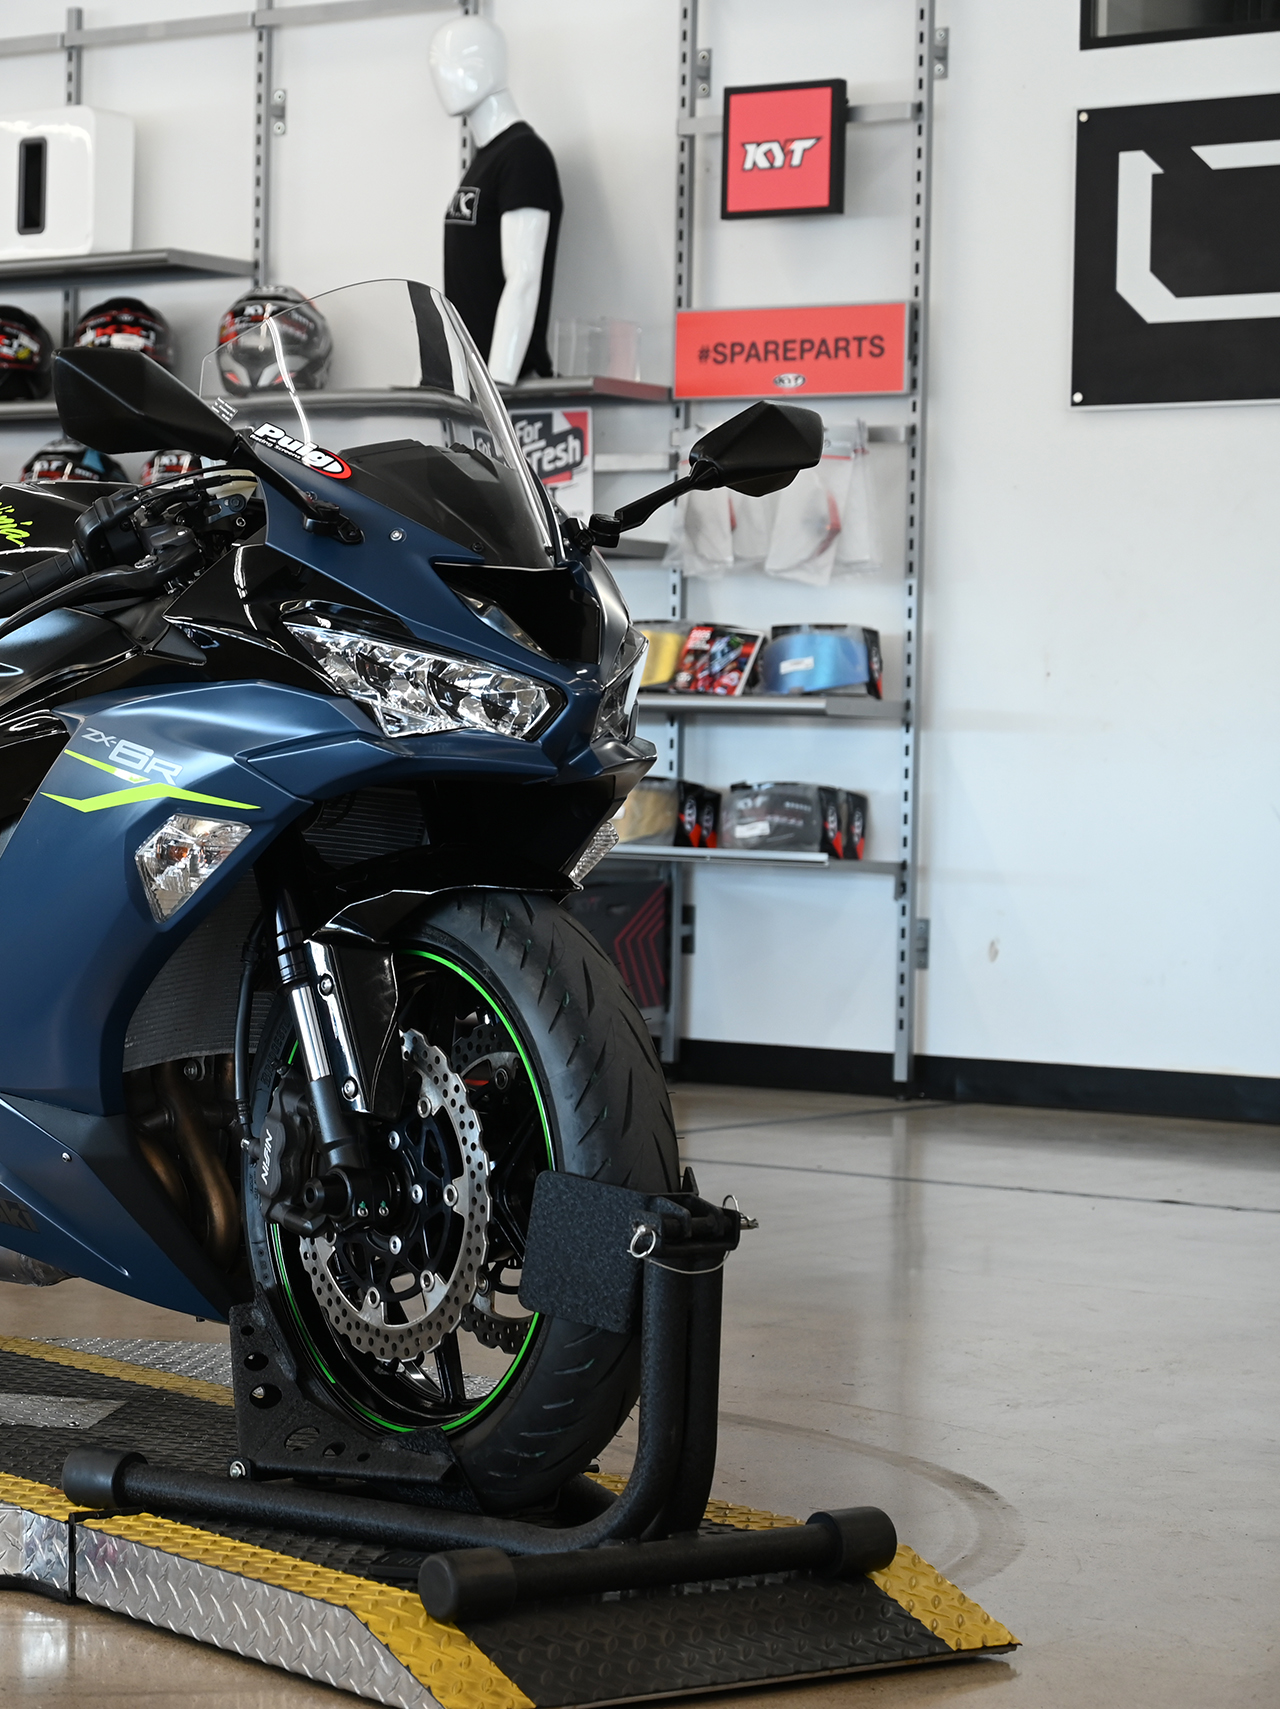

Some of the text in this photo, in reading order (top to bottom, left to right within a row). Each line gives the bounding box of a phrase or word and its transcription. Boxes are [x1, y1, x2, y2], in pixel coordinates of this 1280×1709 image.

[742, 136, 822, 172] KYT
[698, 334, 886, 364] #SPAREPARTS
[253, 422, 334, 468] Puig
[515, 419, 543, 443] For
